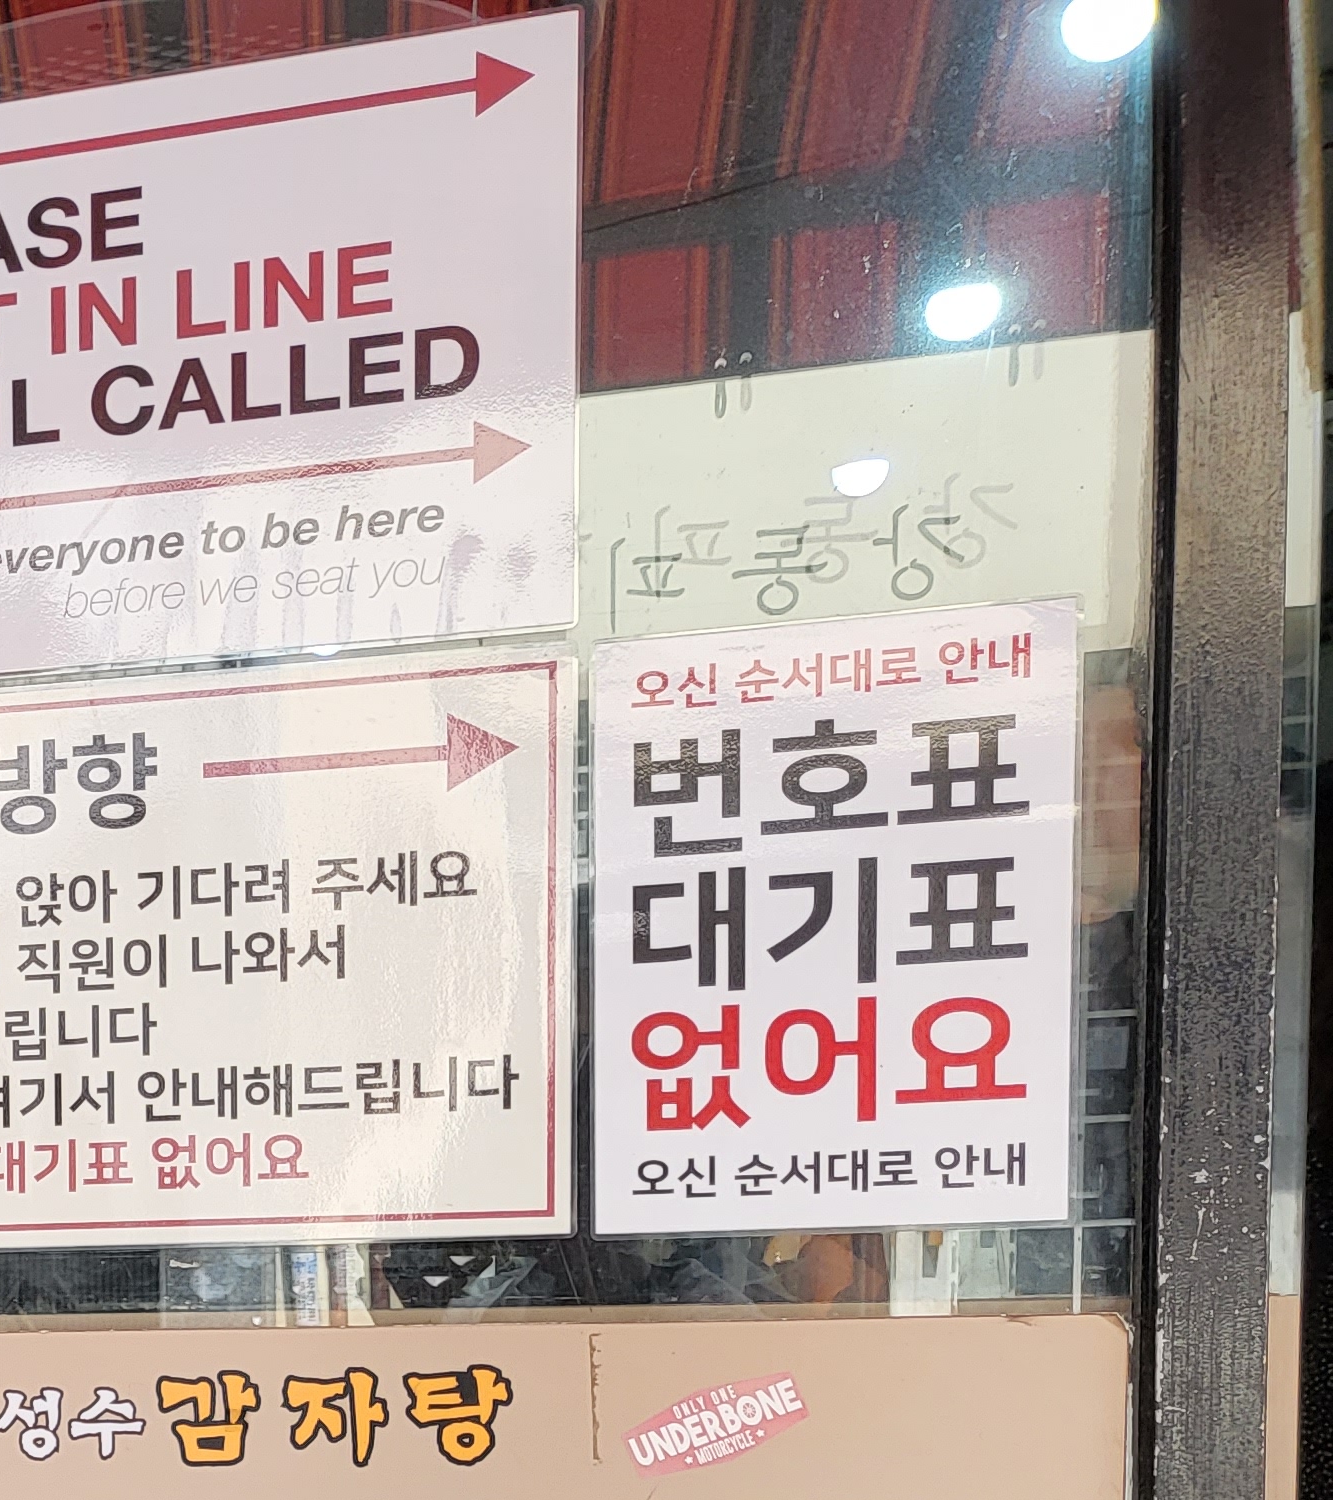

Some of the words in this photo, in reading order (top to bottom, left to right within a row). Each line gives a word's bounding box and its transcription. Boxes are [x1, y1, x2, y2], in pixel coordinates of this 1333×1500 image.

[50, 276, 138, 355] IN
[176, 241, 393, 340] LINE
[90, 325, 482, 437] CALLED
[201, 520, 247, 560] to
[260, 510, 320, 550] be
[335, 500, 446, 543] here
[63, 571, 186, 621] before
[201, 578, 259, 605] we
[271, 561, 356, 602] seat
[370, 555, 446, 603] you
[630, 661, 717, 711] 오신
[734, 644, 921, 706] 순서대로
[938, 631, 1034, 687] 안내
[631, 713, 1031, 859] 번호표
[15, 868, 118, 930] 앉아
[136, 857, 291, 921] 기다려
[312, 849, 478, 908] 주세요
[631, 855, 1029, 992] 대기표
[15, 932, 169, 994] 직원이
[191, 923, 349, 986] 나와서
[137, 1052, 520, 1123] 안내해드립니다
[630, 995, 1027, 1132] 없어요
[152, 1131, 310, 1194] 없어요
[631, 1155, 718, 1200] 오신
[734, 1144, 919, 1198] 순서대로
[933, 1140, 1028, 1190] 안내
[156, 1364, 514, 1467] 감자탕
[627, 1377, 804, 1467] UNDERBONE
[672, 1395, 707, 1421] ONLY
[709, 1384, 738, 1406] ONE
[693, 1429, 757, 1466] MOTORCYCLE
